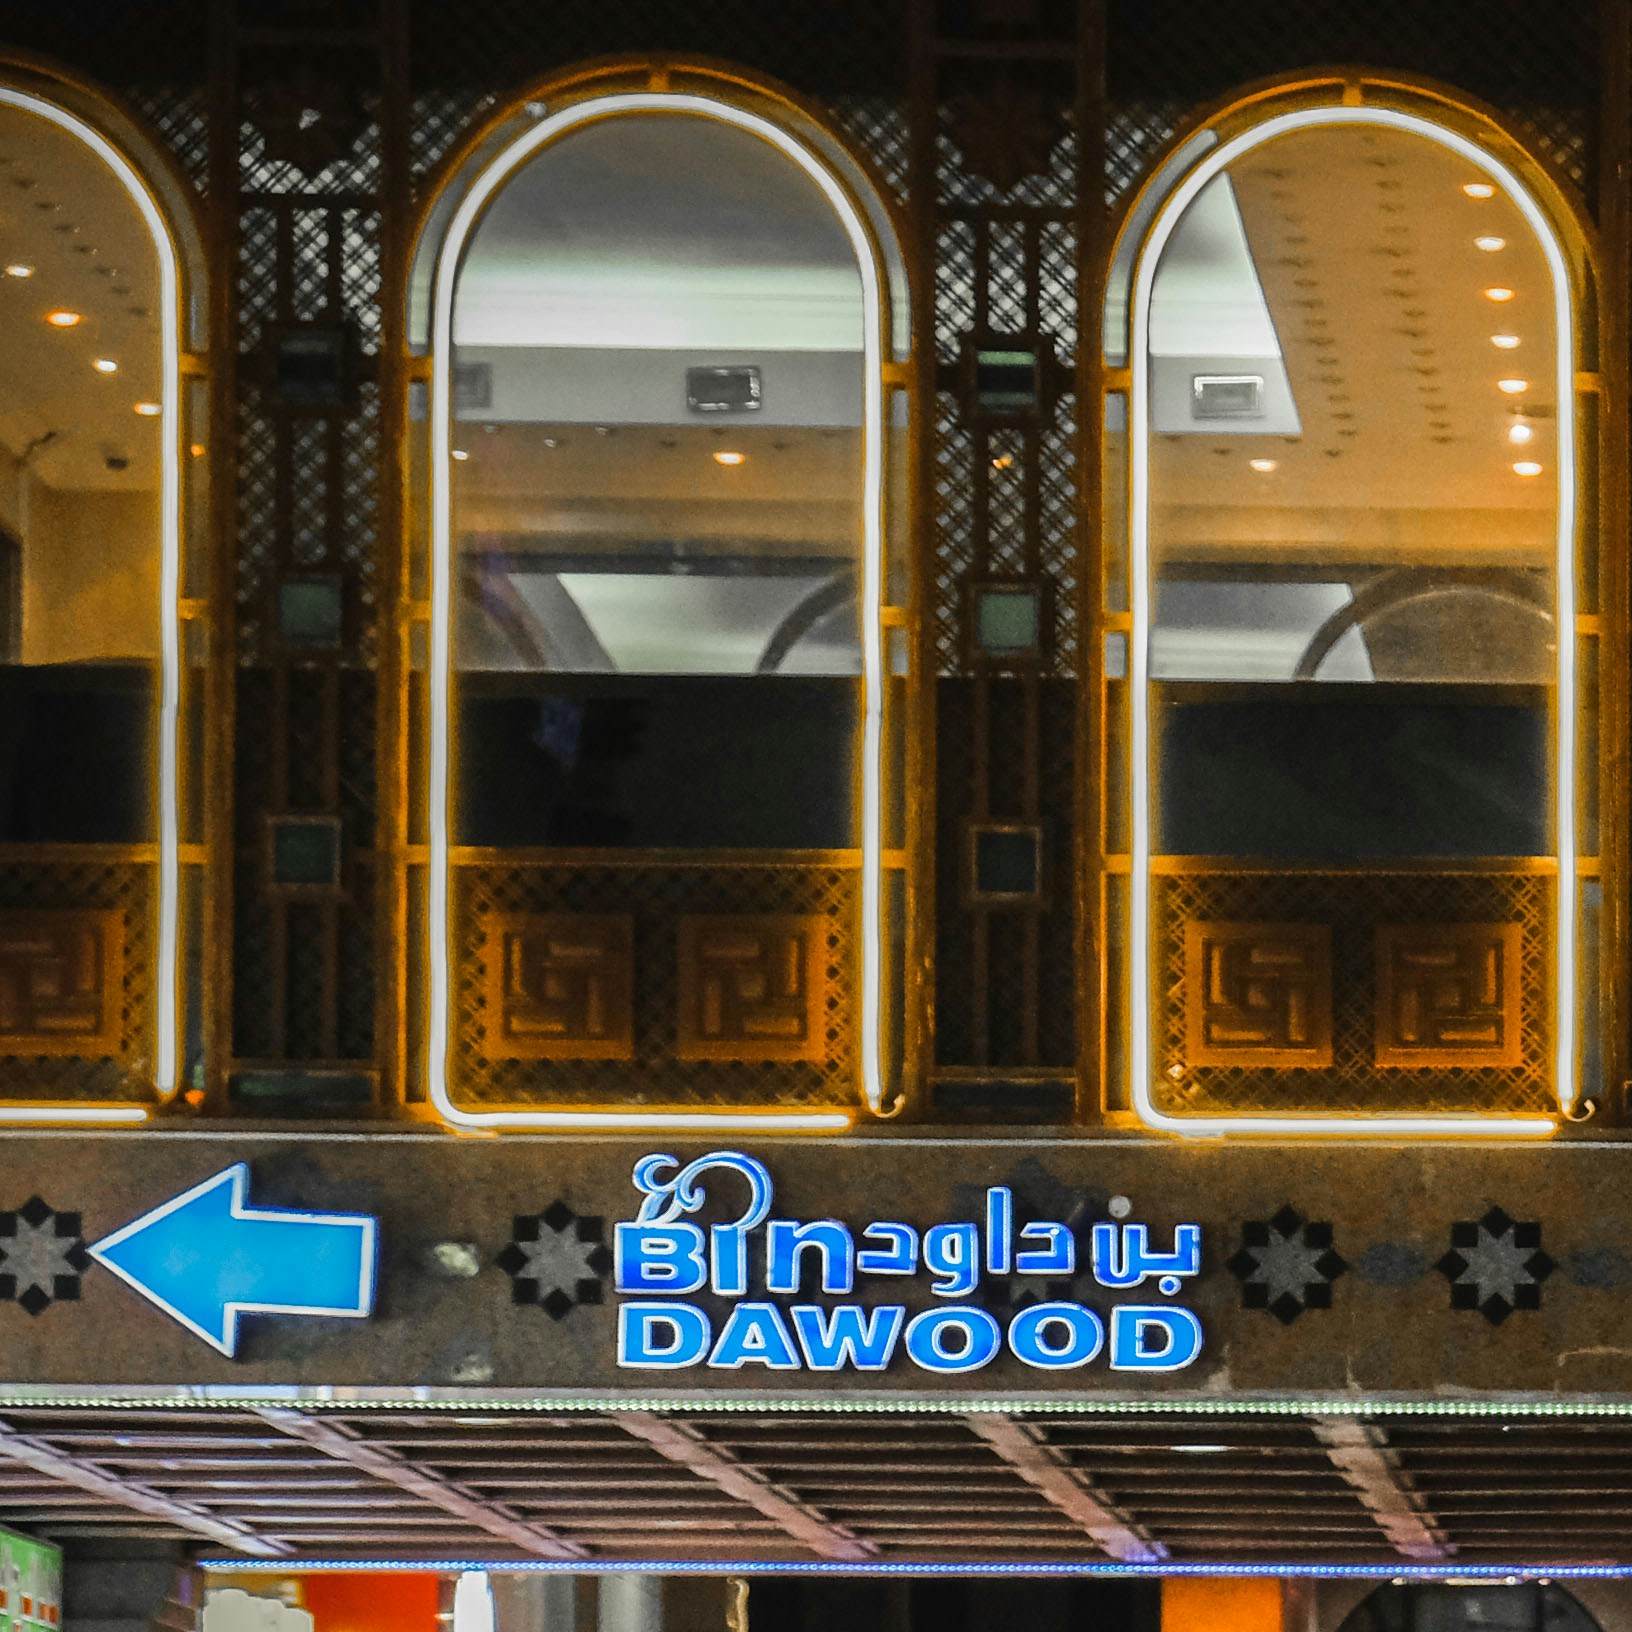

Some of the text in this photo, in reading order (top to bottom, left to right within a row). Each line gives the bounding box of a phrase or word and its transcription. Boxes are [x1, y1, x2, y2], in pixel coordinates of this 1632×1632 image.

[614, 1151, 854, 1296] Bin
[857, 1186, 1202, 1296] بن داود
[616, 1301, 1203, 1374] DAWOOD
